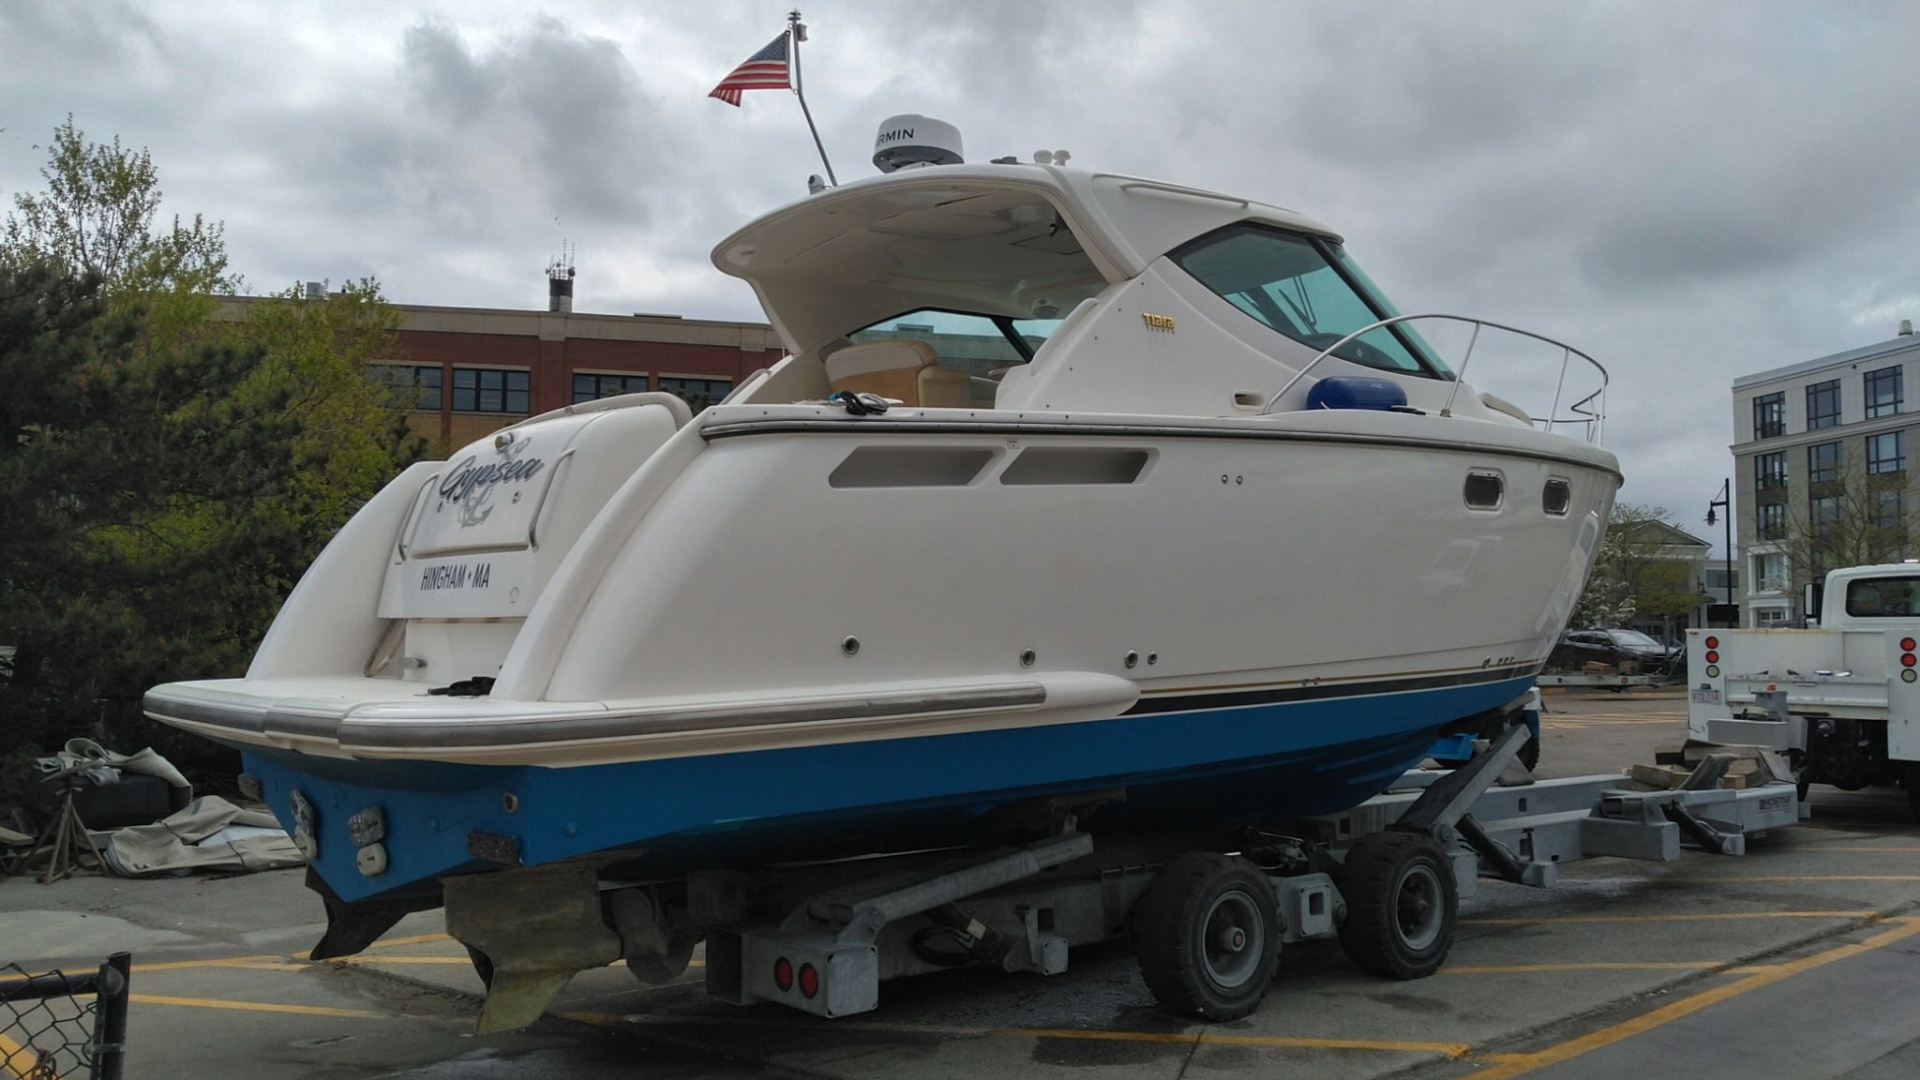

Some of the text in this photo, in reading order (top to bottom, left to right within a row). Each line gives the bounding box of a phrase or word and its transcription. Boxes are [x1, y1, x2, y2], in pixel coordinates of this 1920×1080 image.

[876, 128, 915, 147] RMIN
[440, 455, 545, 503] Gypsea
[420, 563, 491, 591] HINGHAM MA
